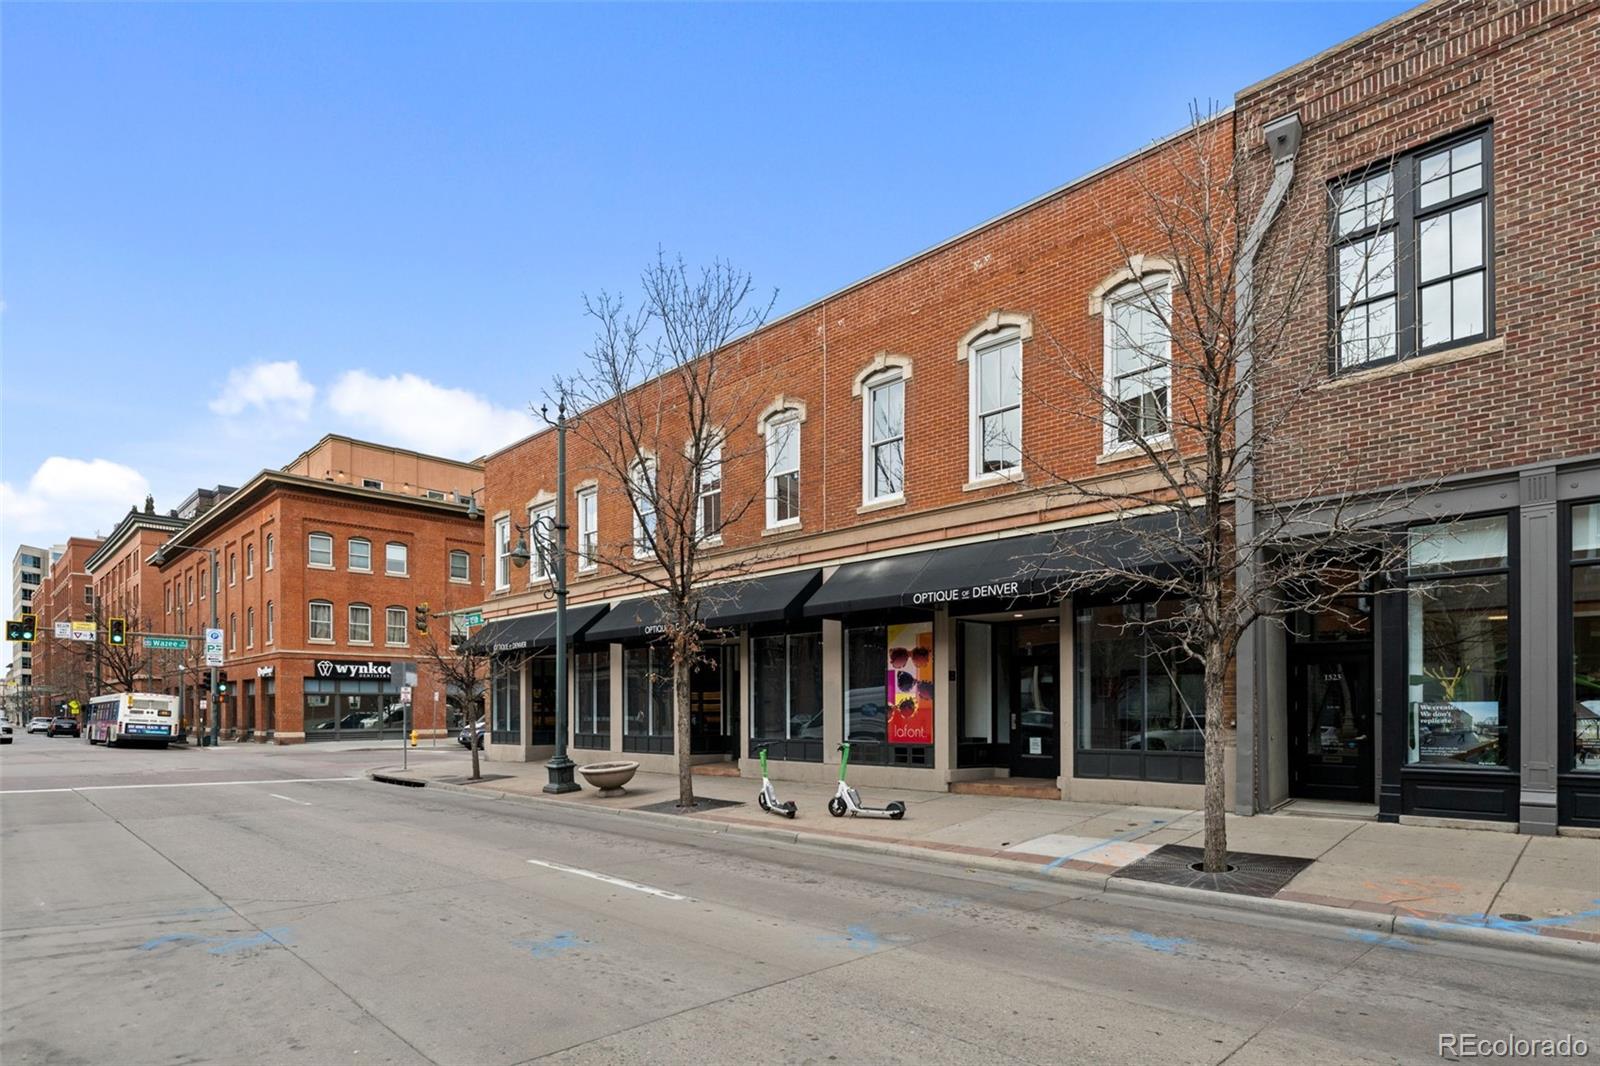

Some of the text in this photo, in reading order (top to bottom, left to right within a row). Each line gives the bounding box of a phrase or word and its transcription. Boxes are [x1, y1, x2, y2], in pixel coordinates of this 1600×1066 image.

[913, 582, 1018, 604] OPTIQUE OF DENVER
[644, 624, 668, 634] OPTIQU
[153, 639, 178, 647] Wazee
[207, 645, 216, 653] P
[334, 662, 392, 677] wynkoo
